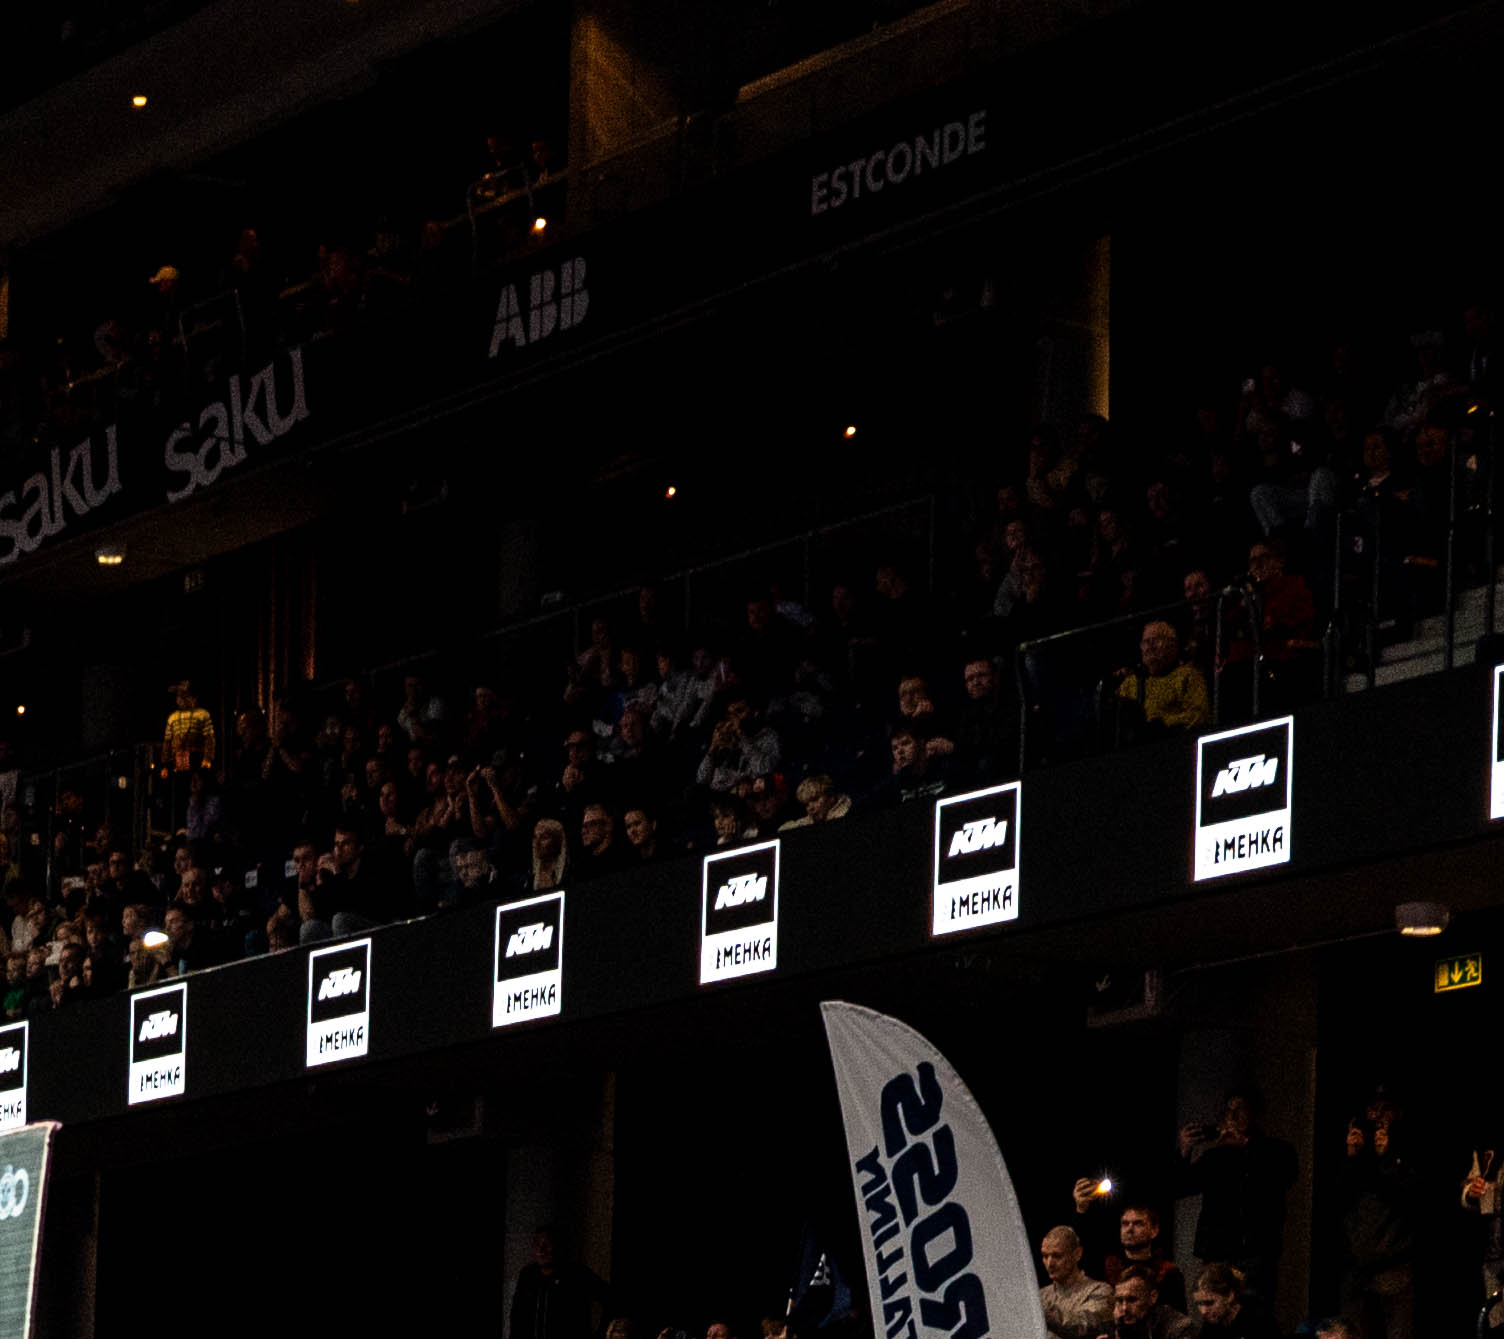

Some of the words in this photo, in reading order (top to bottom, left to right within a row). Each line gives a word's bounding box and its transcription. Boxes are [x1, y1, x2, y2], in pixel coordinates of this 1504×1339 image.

[811, 110, 988, 216] ESTCONDE
[488, 255, 589, 359] ABB
[166, 345, 310, 503] saku
[1211, 753, 1278, 798] KTM
[949, 816, 1007, 858] KTM
[1222, 826, 1283, 862] MEHKA
[715, 872, 767, 911] KTM
[959, 885, 1013, 916] MEHKA
[506, 922, 553, 958] KTM
[722, 936, 771, 968] MEHKA
[319, 967, 361, 1001] KTM
[513, 983, 557, 1013] MEHKA
